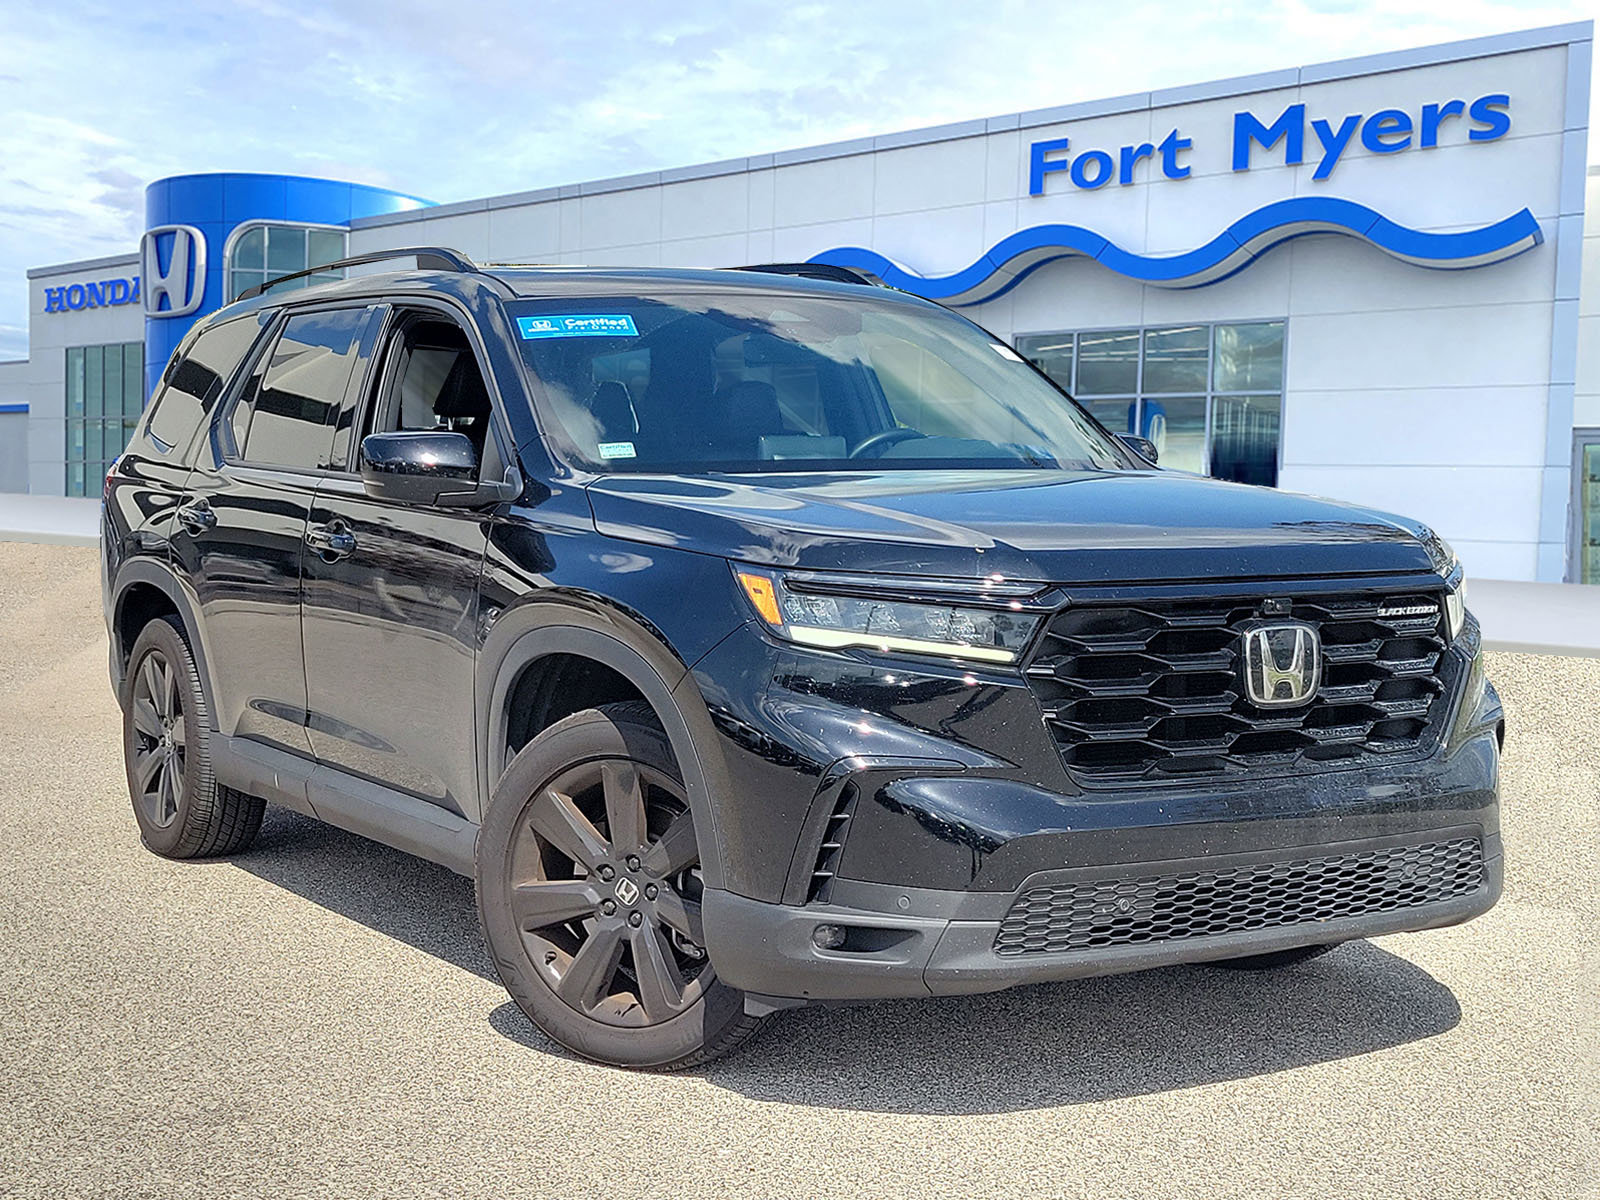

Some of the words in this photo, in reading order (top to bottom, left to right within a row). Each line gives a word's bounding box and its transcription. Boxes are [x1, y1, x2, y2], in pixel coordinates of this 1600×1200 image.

[1029, 128, 1193, 196] Fort
[1231, 94, 1511, 181] Myers
[564, 318, 628, 327] Certified
